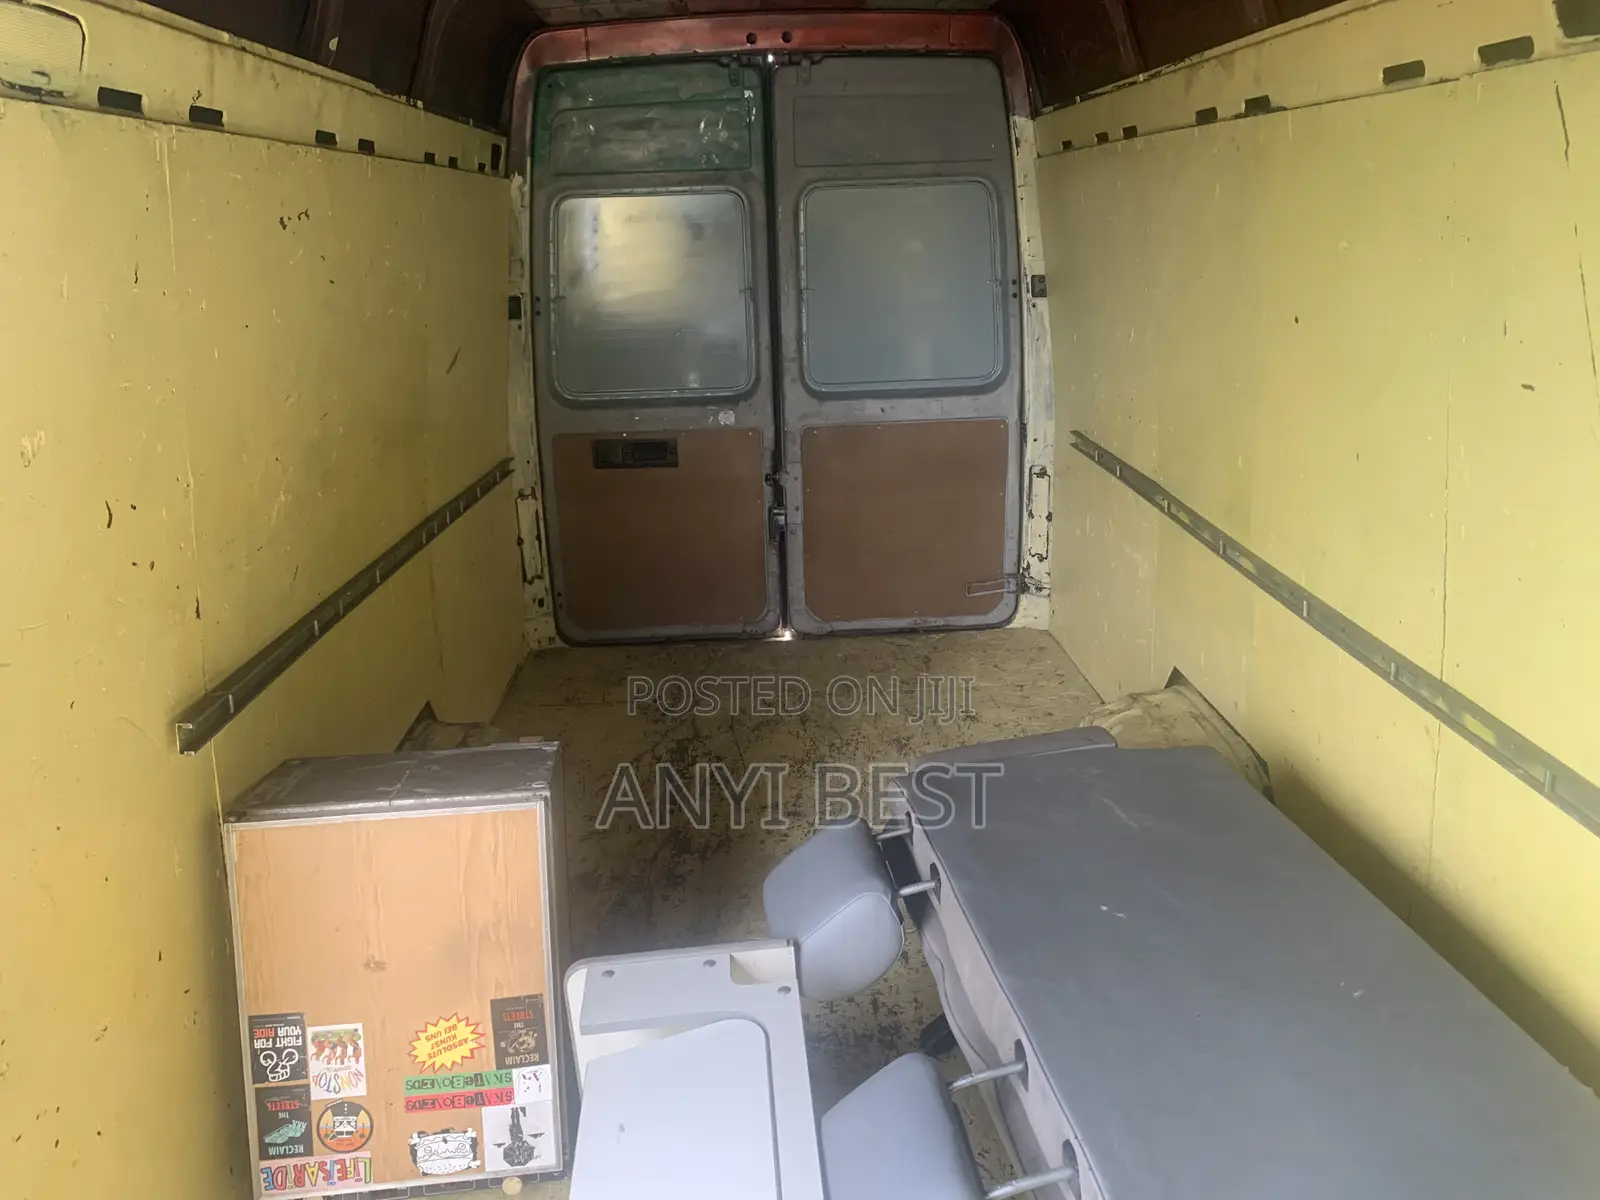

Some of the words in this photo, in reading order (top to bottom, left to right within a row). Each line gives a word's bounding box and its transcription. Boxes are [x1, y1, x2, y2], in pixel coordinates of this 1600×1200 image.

[253, 1028, 275, 1038] RIDE
[277, 1025, 302, 1037] YOUR
[444, 1024, 458, 1032] BEI
[275, 1036, 302, 1047] FIGHT
[424, 1030, 442, 1042] UNS
[430, 1034, 457, 1049] KUNST
[254, 1038, 272, 1049] FOR
[426, 1037, 469, 1060] ABSOLUTE
[505, 1053, 539, 1065] RECLAIM
[268, 1144, 304, 1155] RECLAIM
